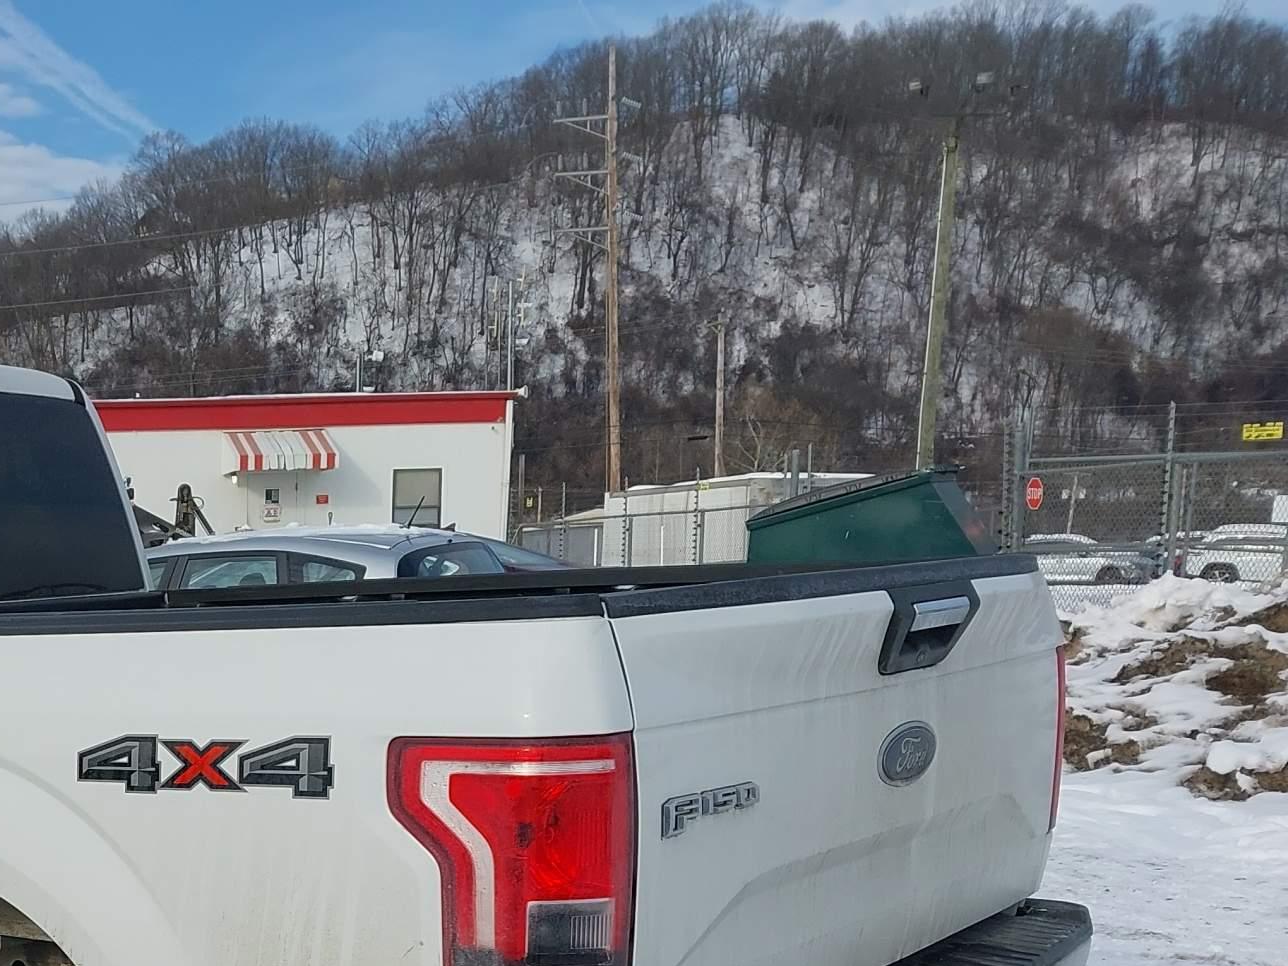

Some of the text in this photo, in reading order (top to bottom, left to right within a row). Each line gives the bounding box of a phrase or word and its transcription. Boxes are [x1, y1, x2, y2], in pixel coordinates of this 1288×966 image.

[1027, 487, 1042, 501] STOP
[895, 736, 927, 773] Ford
[660, 780, 761, 841] F150
